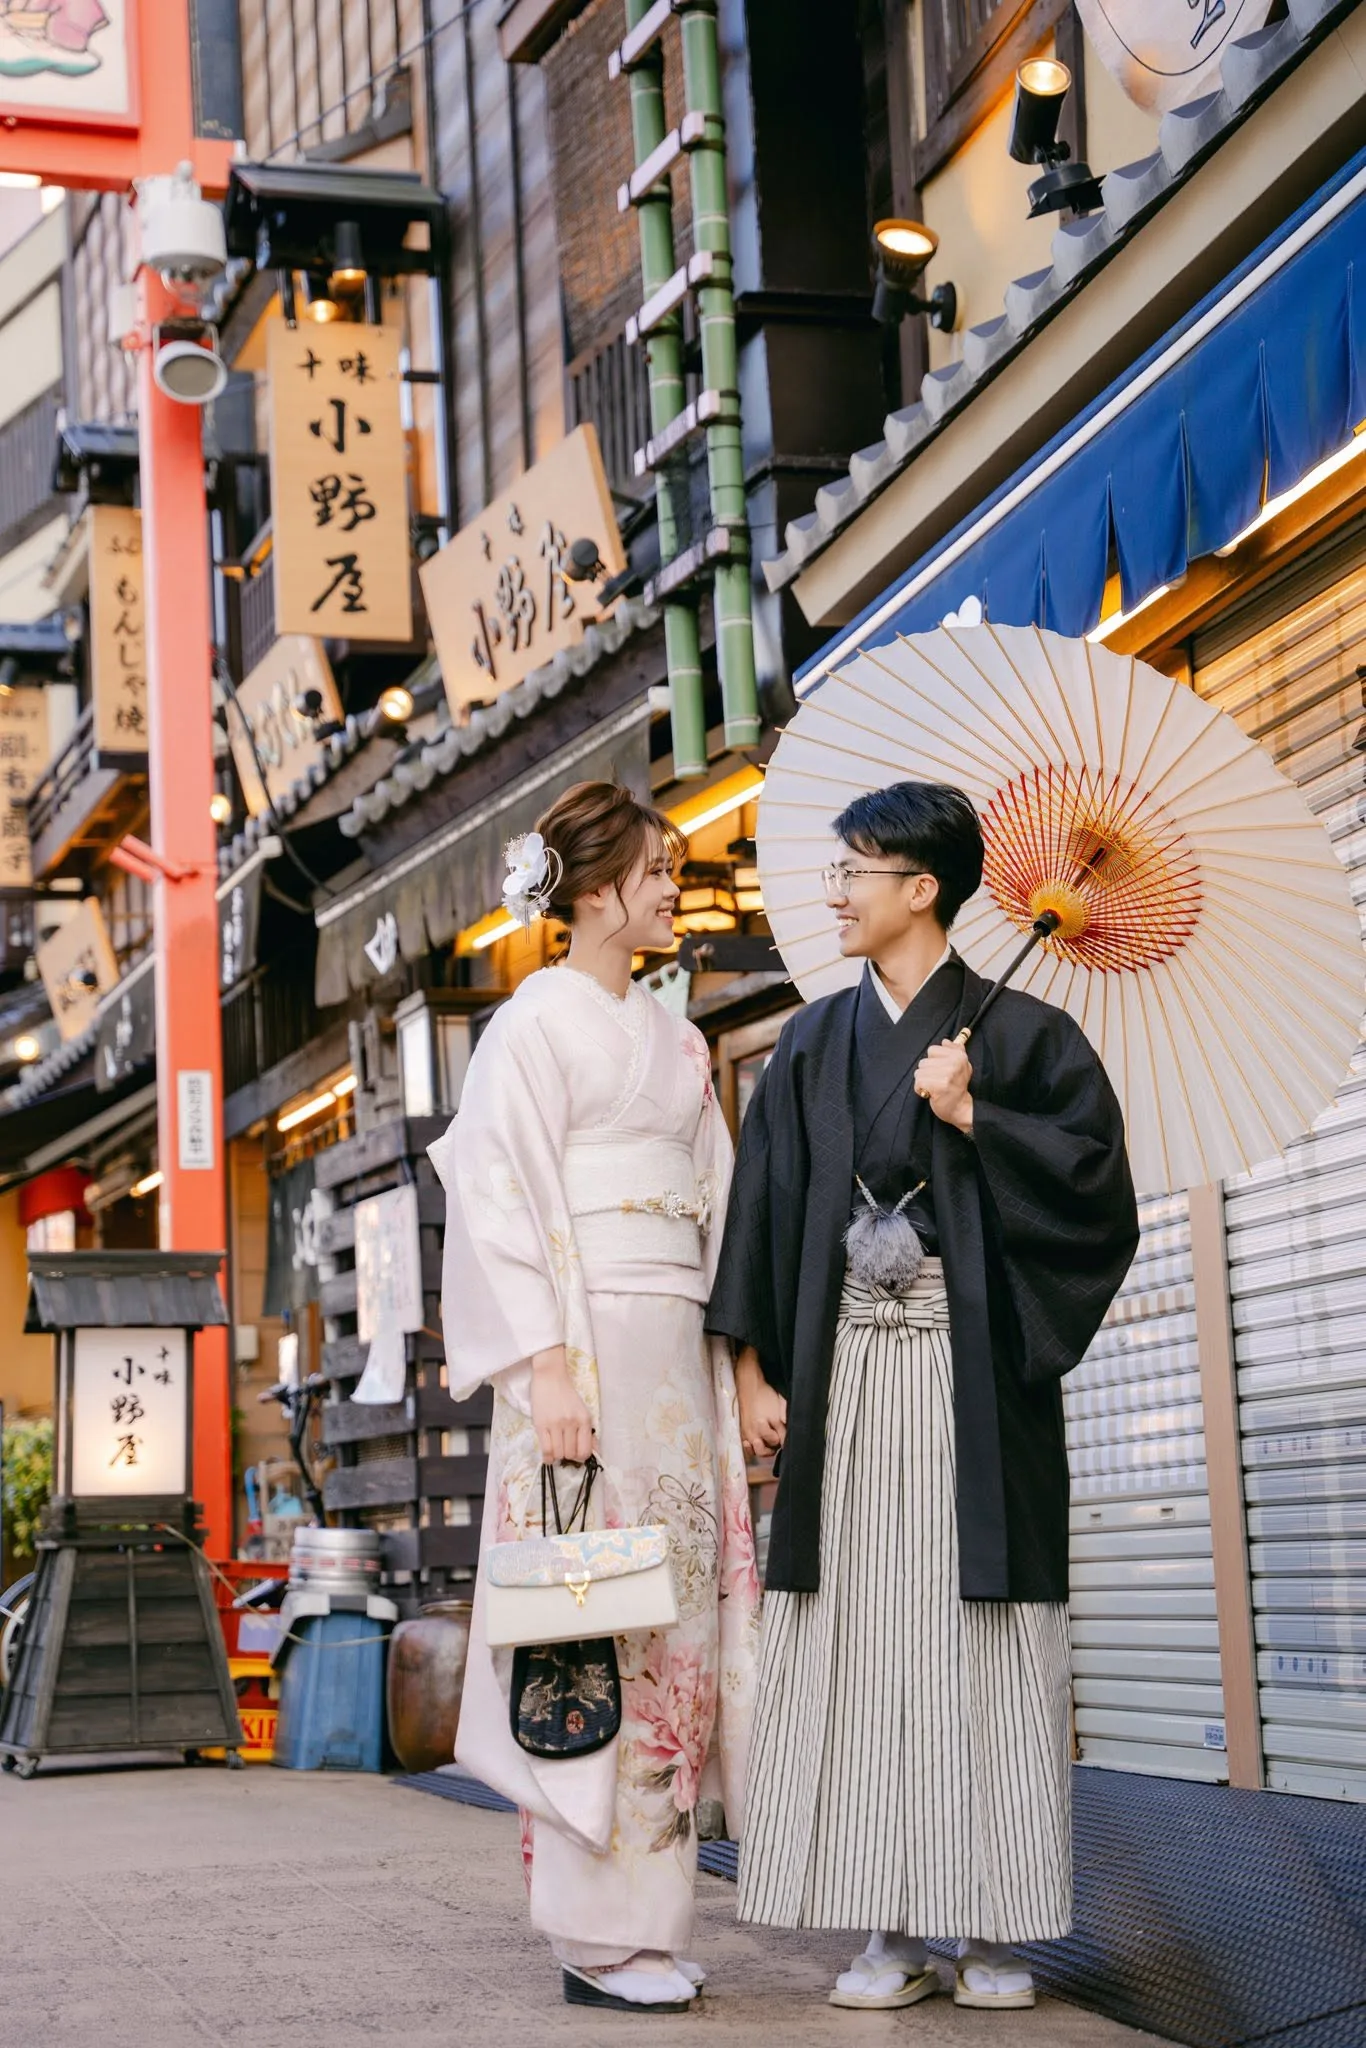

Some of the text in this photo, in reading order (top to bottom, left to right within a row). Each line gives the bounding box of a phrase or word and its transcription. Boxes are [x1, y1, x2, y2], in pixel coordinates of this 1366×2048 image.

[298, 348, 376, 385] 十味
[307, 398, 377, 613] 小野屋
[152, 1345, 174, 1386] 十味
[109, 1355, 147, 1468] 小野屋
